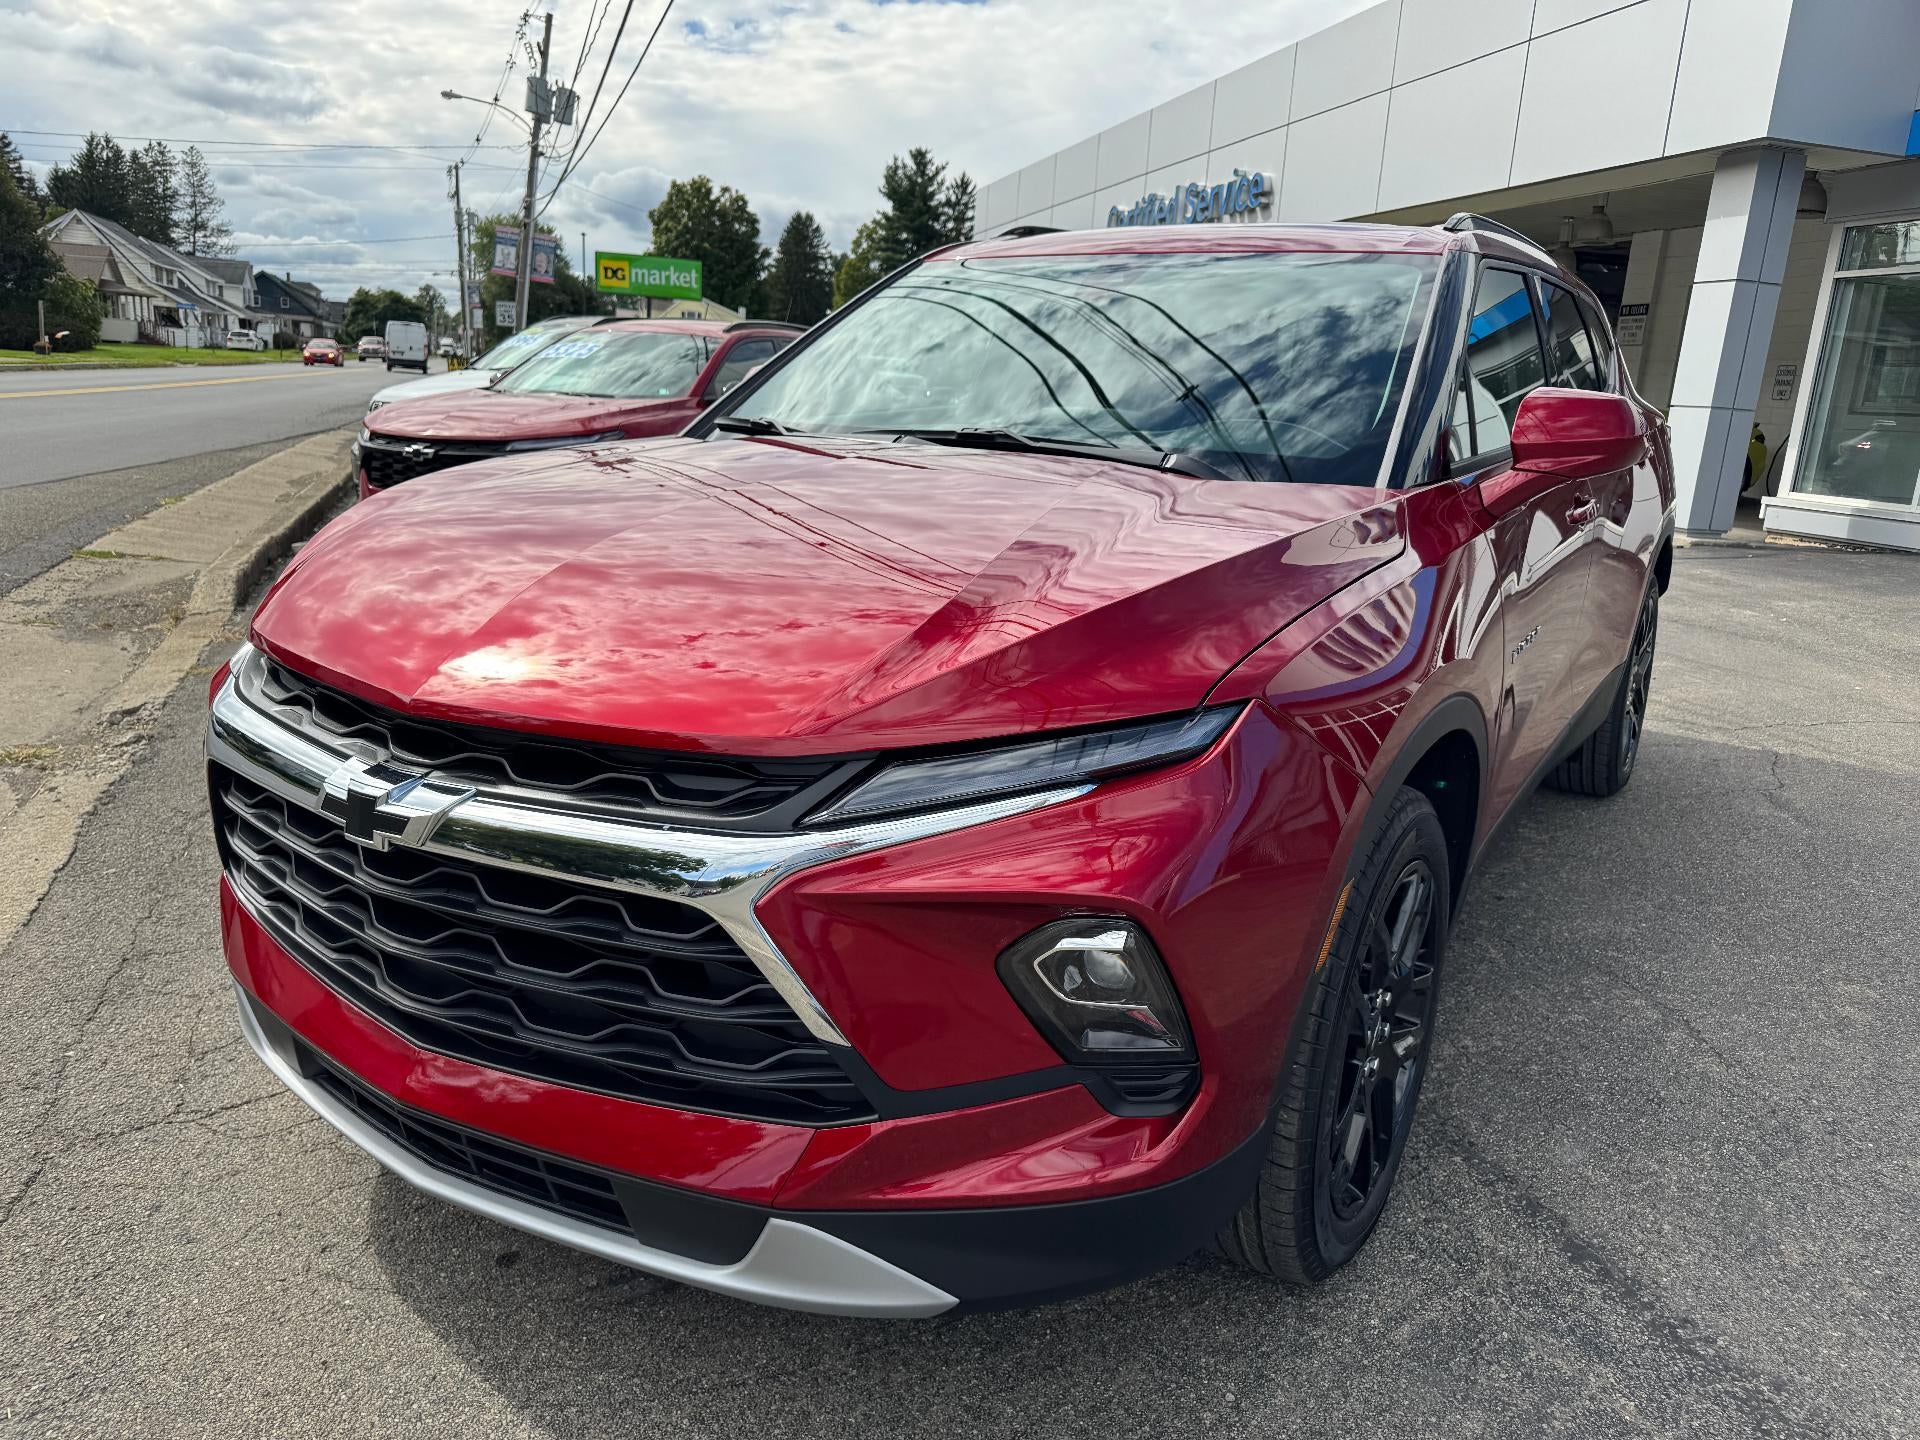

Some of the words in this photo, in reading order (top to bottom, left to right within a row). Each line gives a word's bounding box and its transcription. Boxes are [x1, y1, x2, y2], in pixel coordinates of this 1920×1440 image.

[1184, 168, 1265, 224] Service
[603, 266, 626, 280] DG
[631, 266, 698, 289] market
[499, 313, 515, 323] 35
